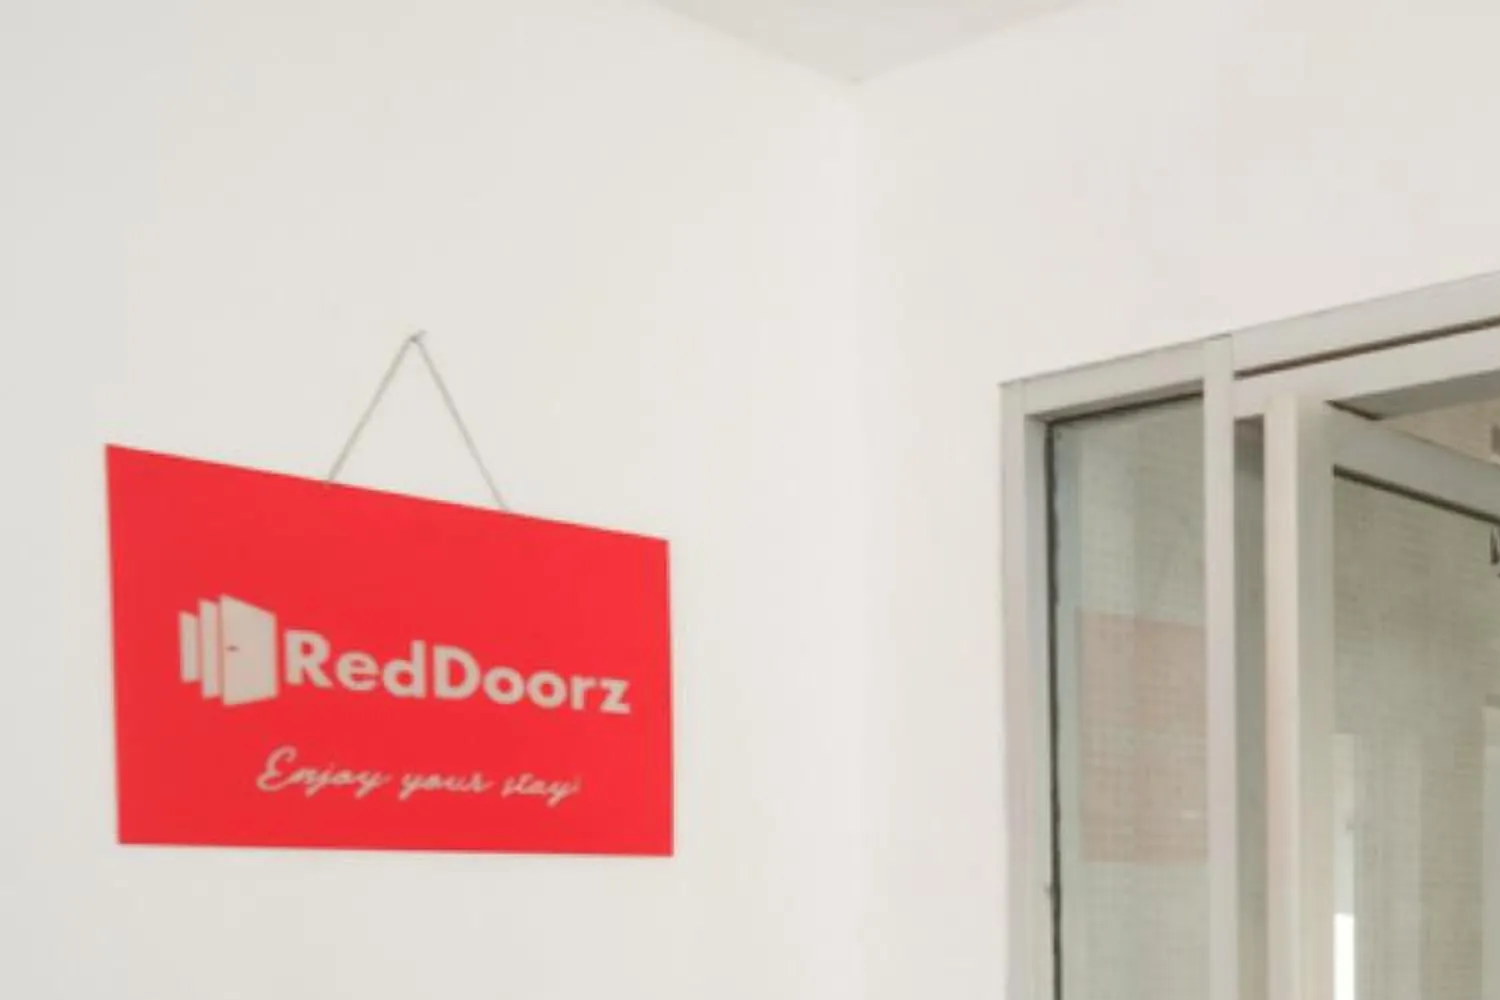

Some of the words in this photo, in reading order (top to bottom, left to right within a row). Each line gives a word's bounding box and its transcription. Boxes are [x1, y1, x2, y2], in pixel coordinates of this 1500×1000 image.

[284, 629, 632, 716] RedDoorz
[255, 745, 393, 799] Enjoy
[397, 770, 496, 801] your
